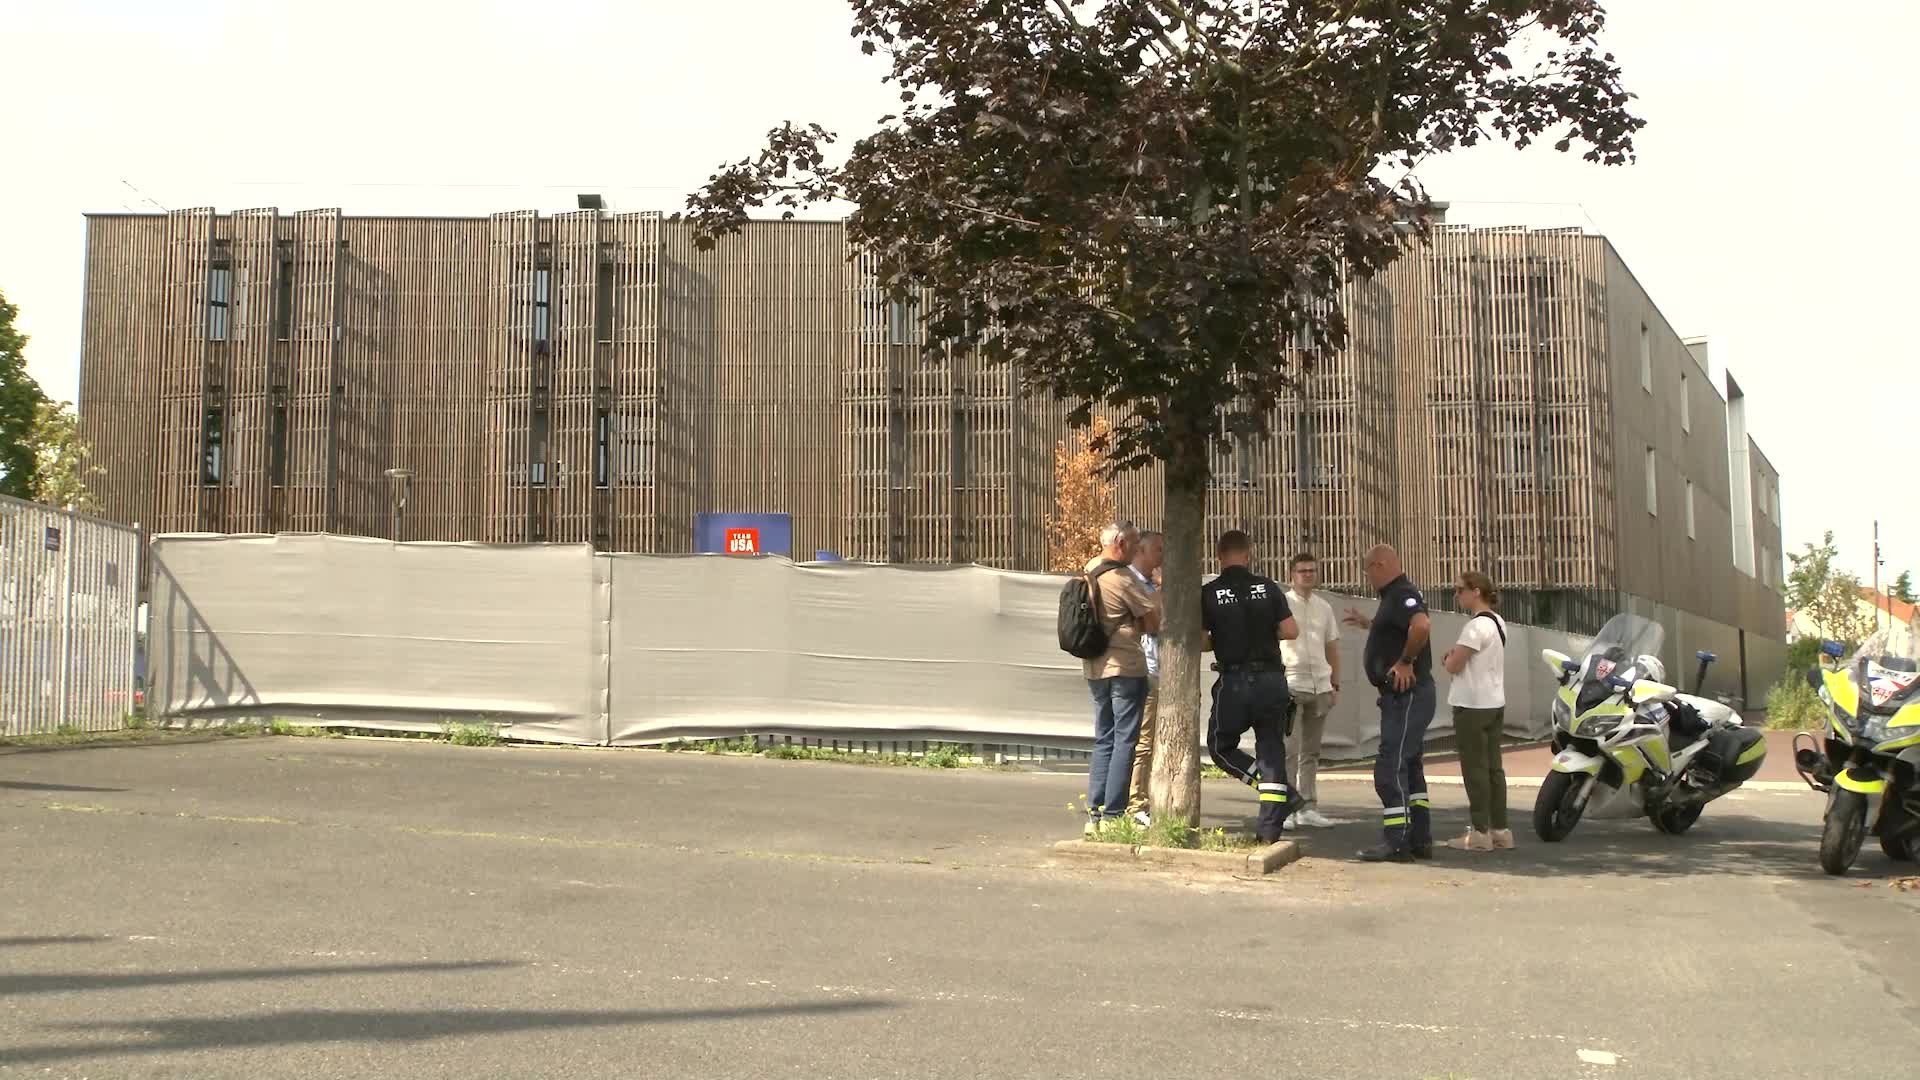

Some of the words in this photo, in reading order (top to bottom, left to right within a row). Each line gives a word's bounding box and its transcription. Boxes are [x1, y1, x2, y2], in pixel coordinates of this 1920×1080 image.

[730, 539, 754, 552] USA
[1216, 584, 1266, 599] POCE
[1217, 593, 1268, 605] NATIALE
